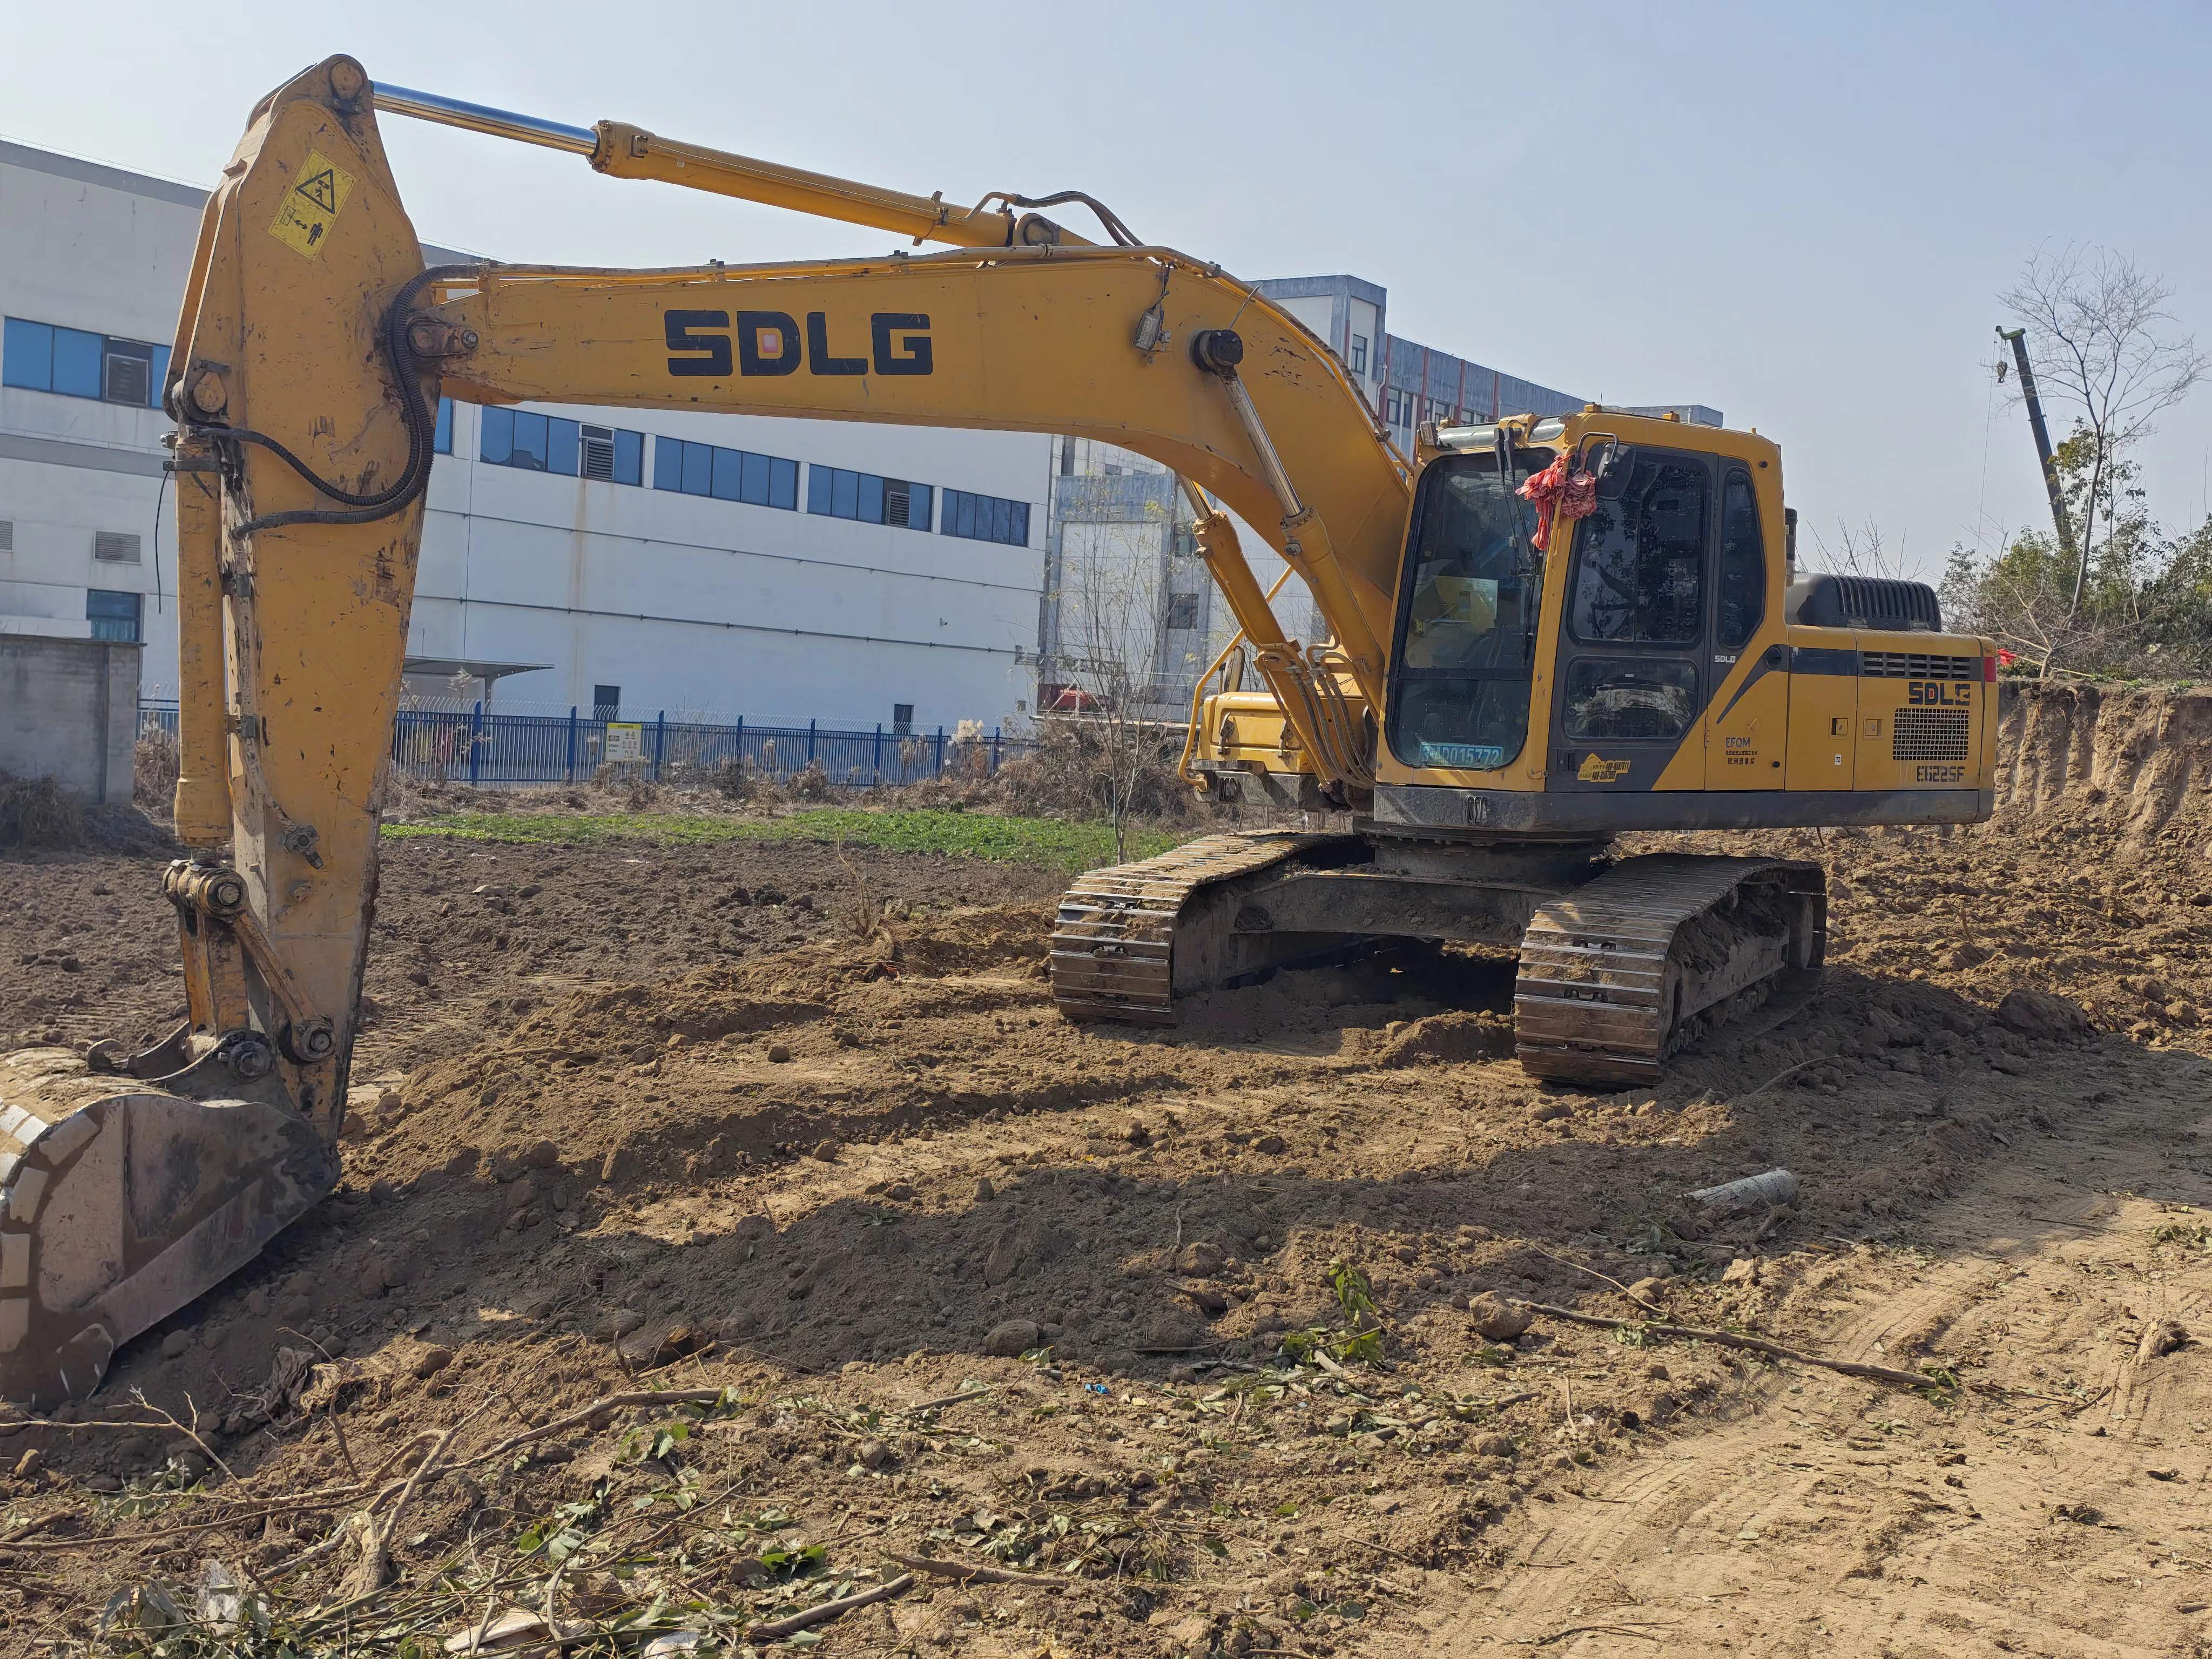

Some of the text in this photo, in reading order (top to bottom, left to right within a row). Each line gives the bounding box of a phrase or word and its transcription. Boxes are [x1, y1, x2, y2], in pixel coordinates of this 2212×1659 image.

[664, 309, 933, 376] SDLG
[1715, 655, 1736, 663] SDLG
[1909, 682, 1971, 706] SDLG
